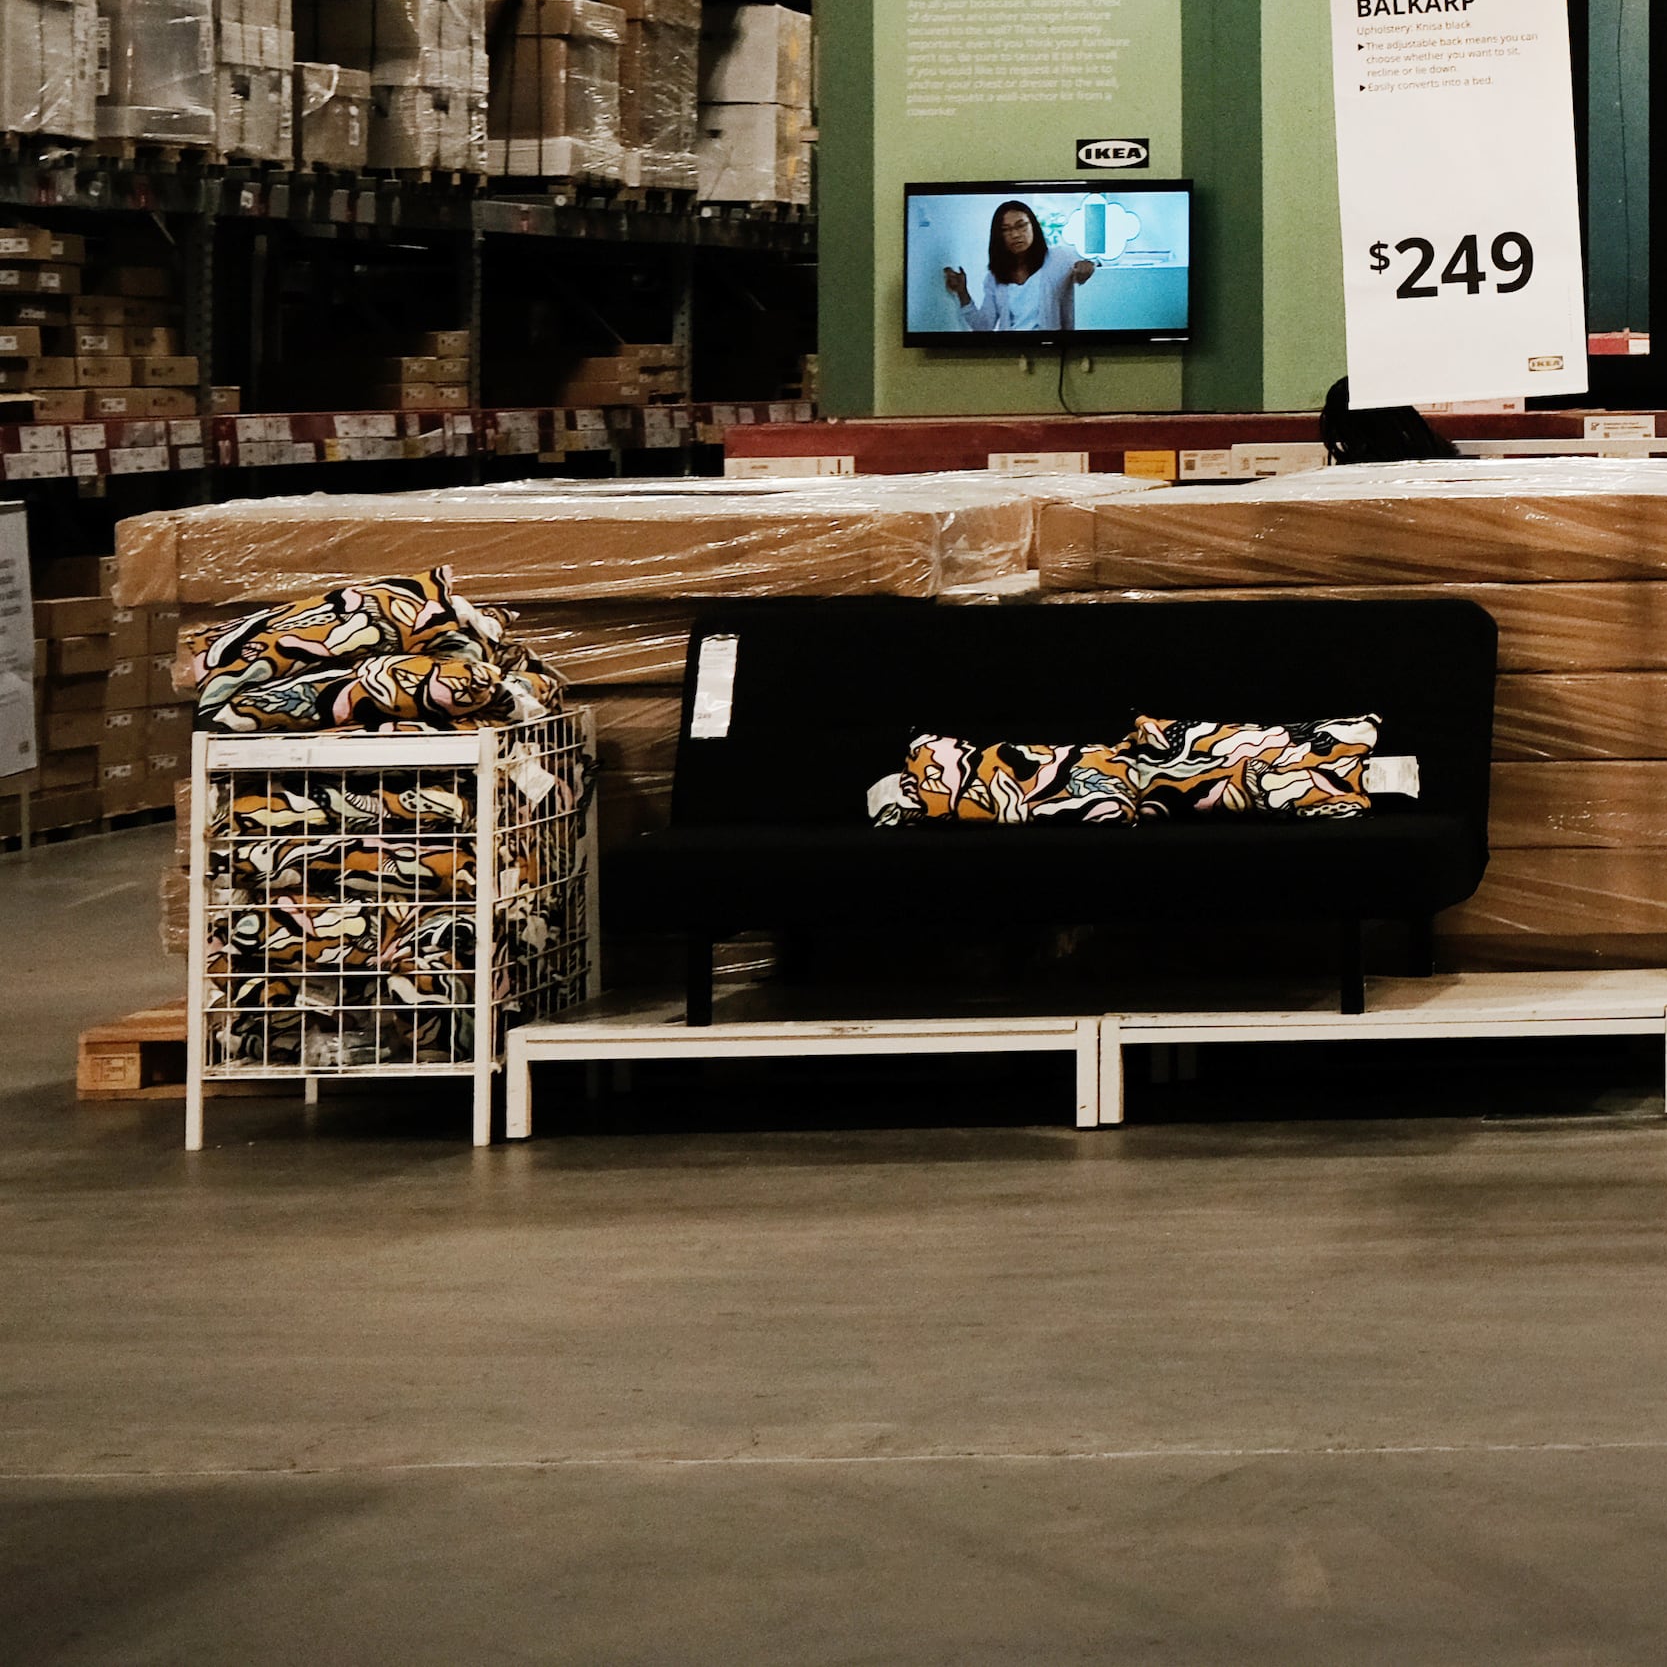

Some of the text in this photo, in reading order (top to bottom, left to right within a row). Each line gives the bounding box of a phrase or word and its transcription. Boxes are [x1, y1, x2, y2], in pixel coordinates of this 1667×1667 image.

[1499, 34, 1519, 45] you
[1085, 146, 1142, 160] IKEA
[1368, 230, 1535, 300] $249
